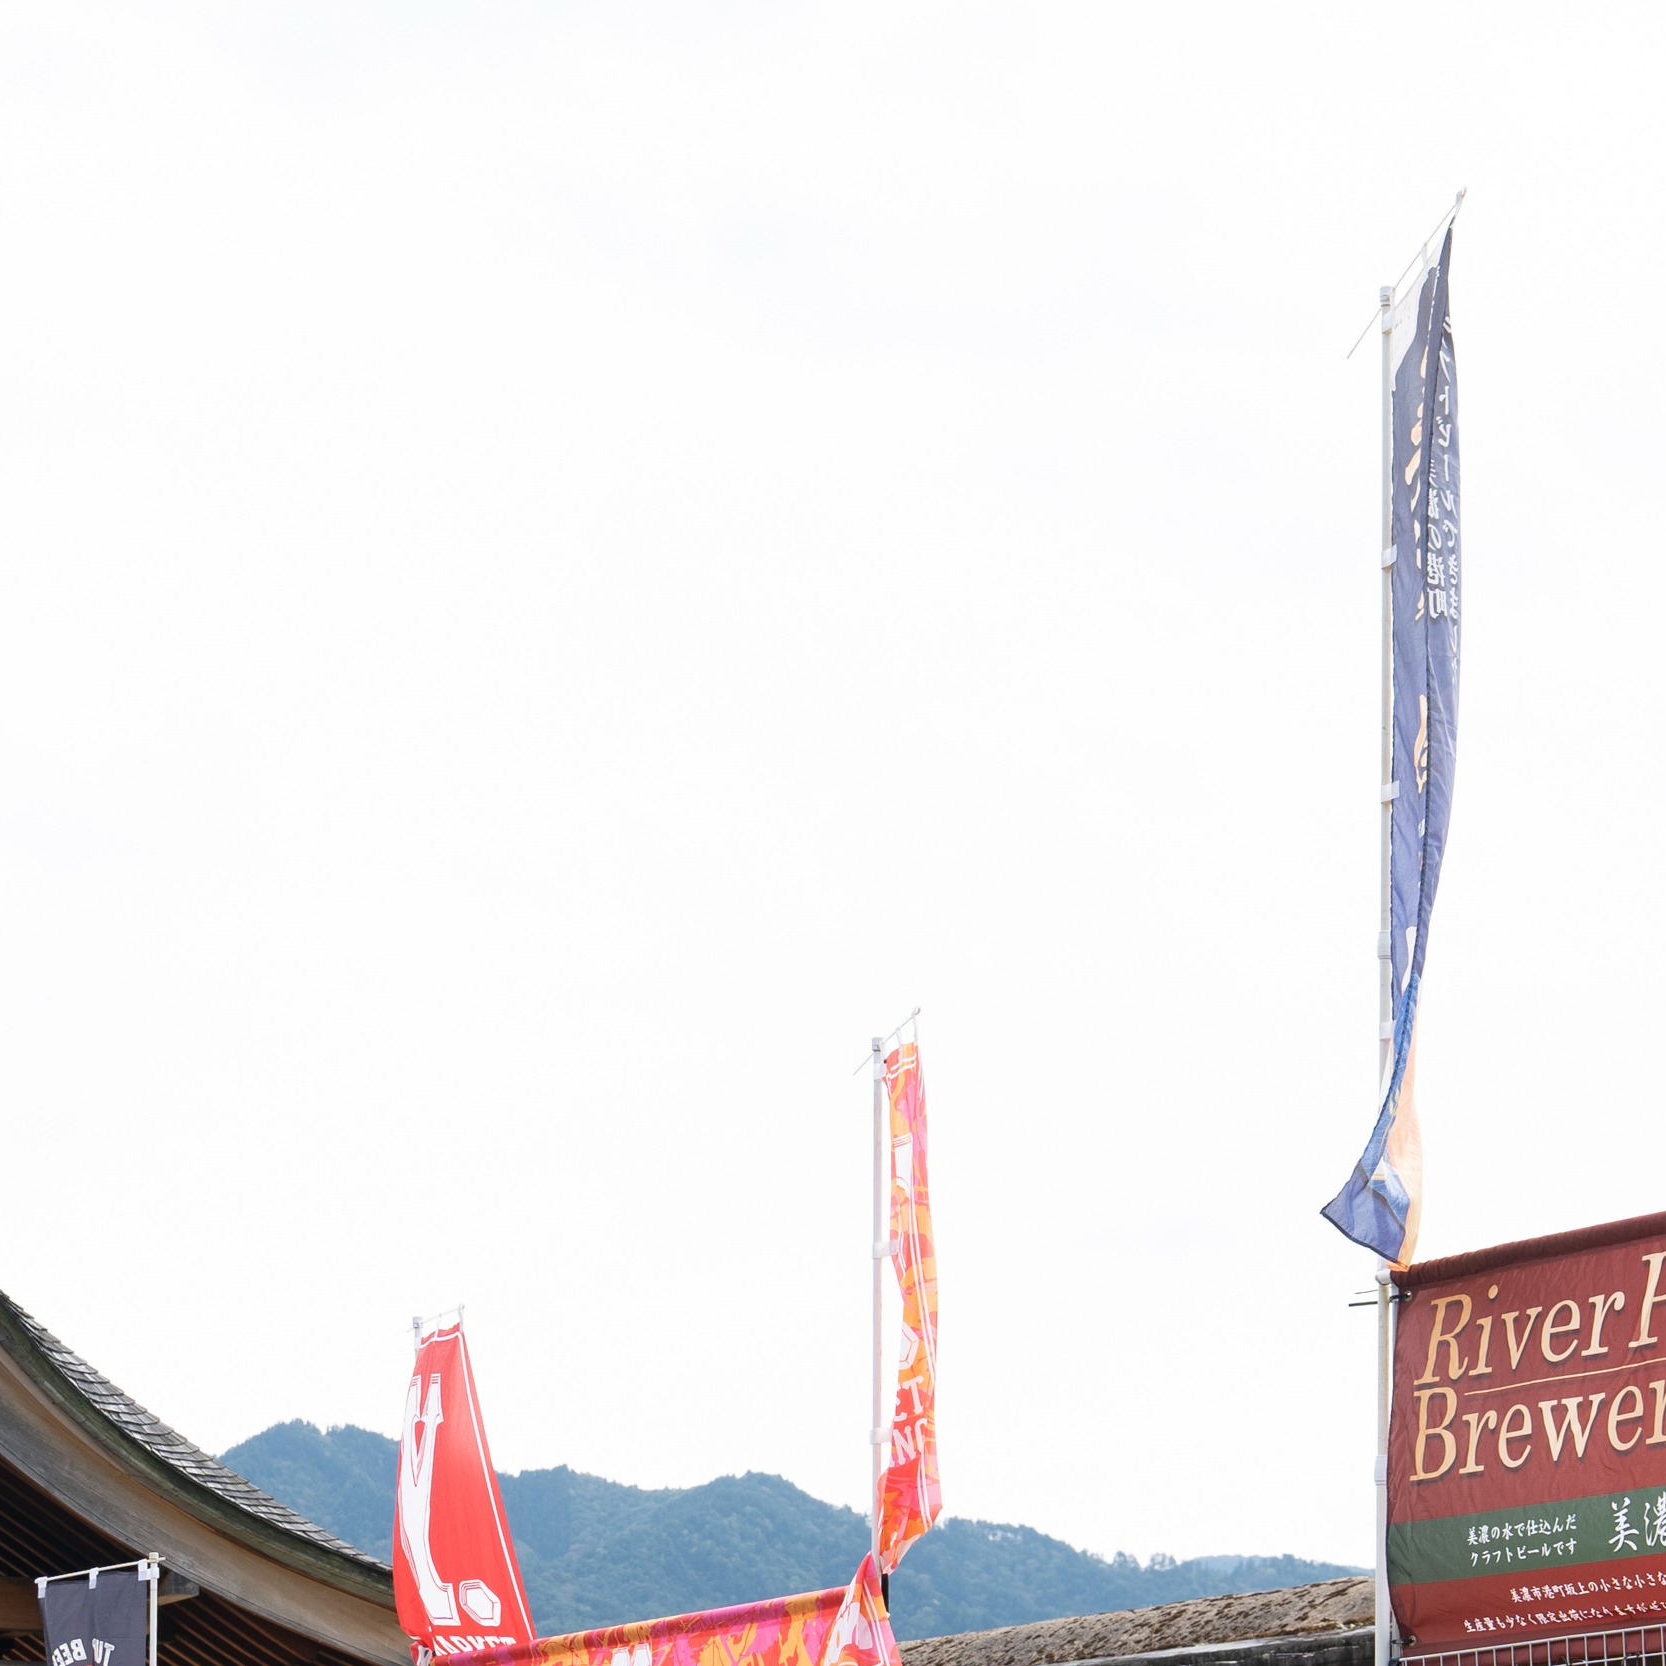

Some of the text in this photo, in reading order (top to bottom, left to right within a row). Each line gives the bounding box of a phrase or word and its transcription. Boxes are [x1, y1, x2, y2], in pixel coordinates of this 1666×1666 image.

[1414, 1284, 1625, 1386] River
[1466, 1512, 1578, 1547] 美濃の水で仕込んだ
[1469, 1539, 1578, 1568] クラフトビールです
